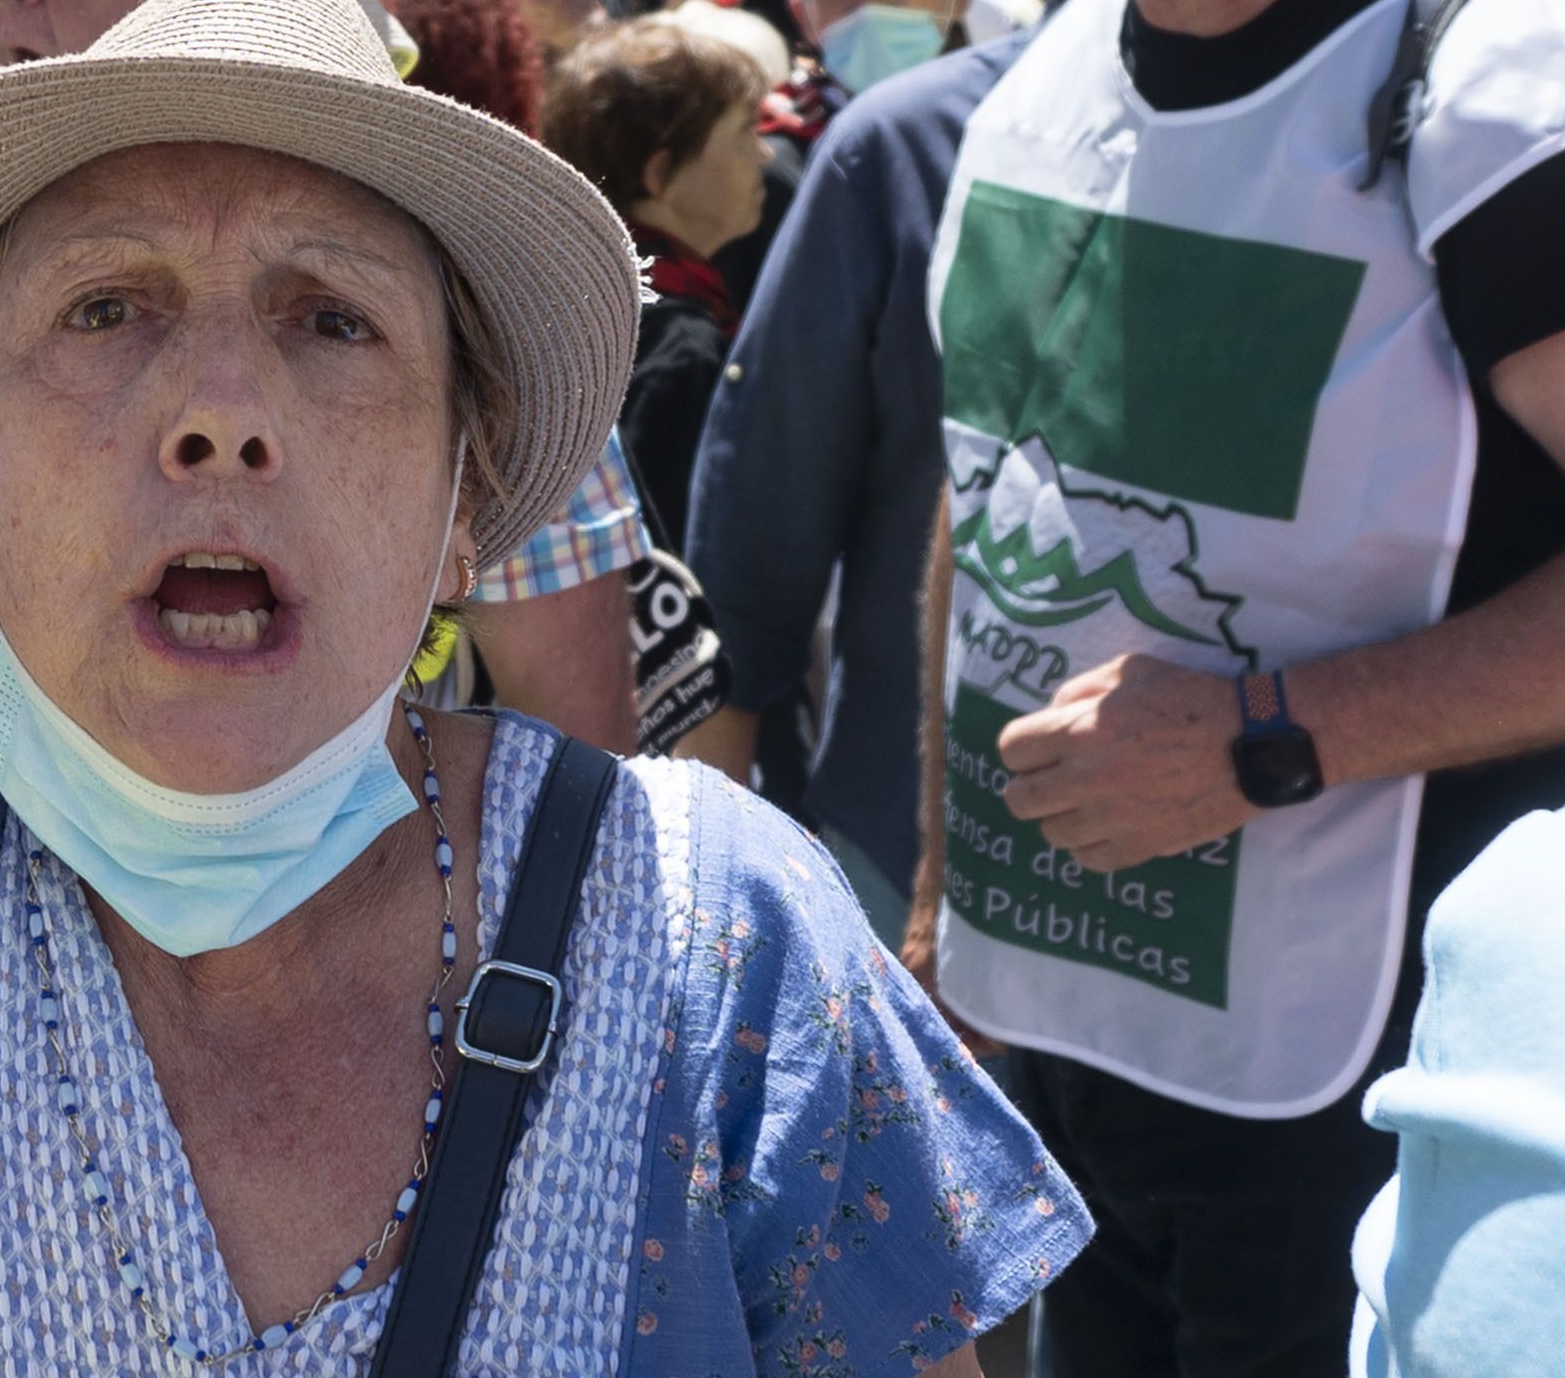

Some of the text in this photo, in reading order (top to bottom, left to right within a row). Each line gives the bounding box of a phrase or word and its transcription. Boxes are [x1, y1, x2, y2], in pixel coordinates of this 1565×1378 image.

[1032, 844, 1084, 889] de
[1105, 871, 1175, 919] las
[983, 886, 1191, 985] Públicas
